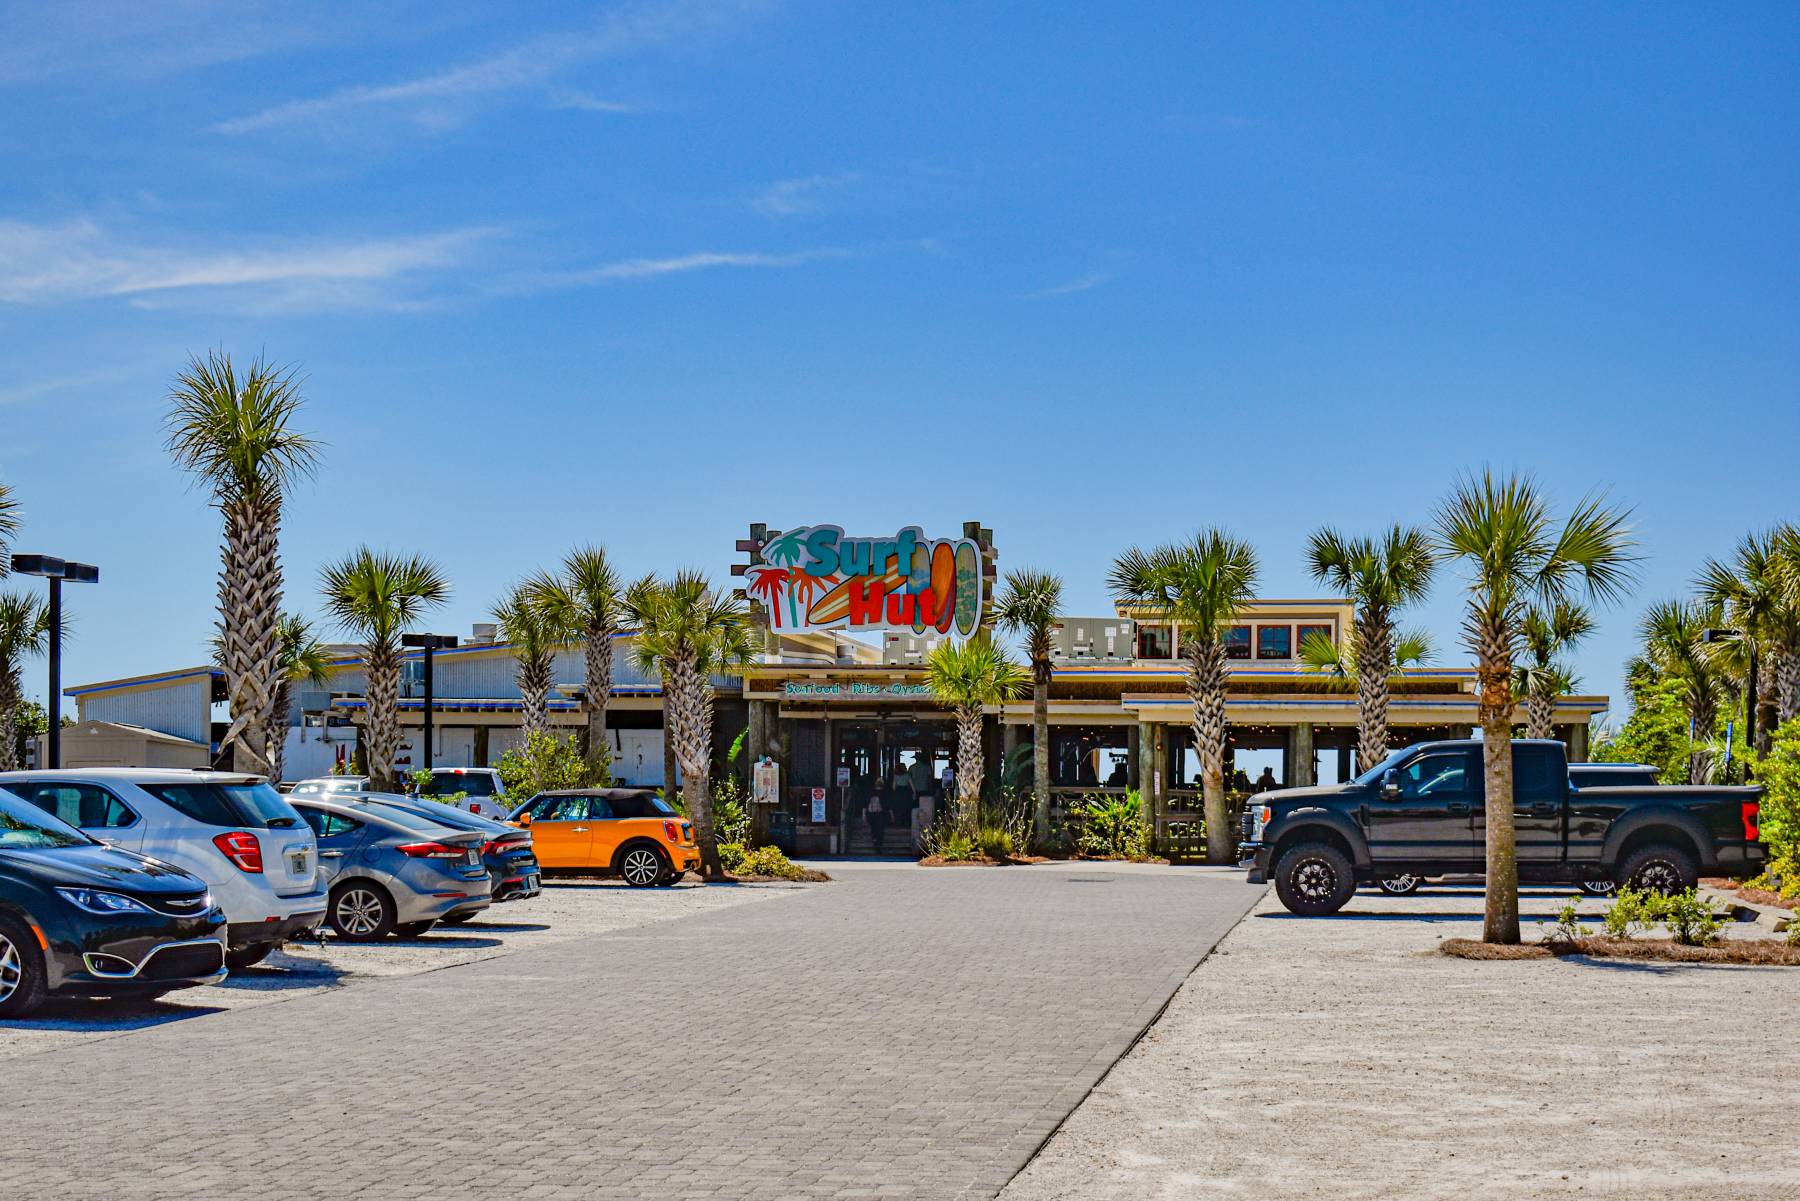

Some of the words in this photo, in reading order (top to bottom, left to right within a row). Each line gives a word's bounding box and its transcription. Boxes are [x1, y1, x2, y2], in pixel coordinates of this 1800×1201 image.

[805, 529, 916, 577] Surf
[849, 582, 937, 627] Hut
[786, 682, 840, 695] Seafood
[852, 682, 880, 695] Ribs
